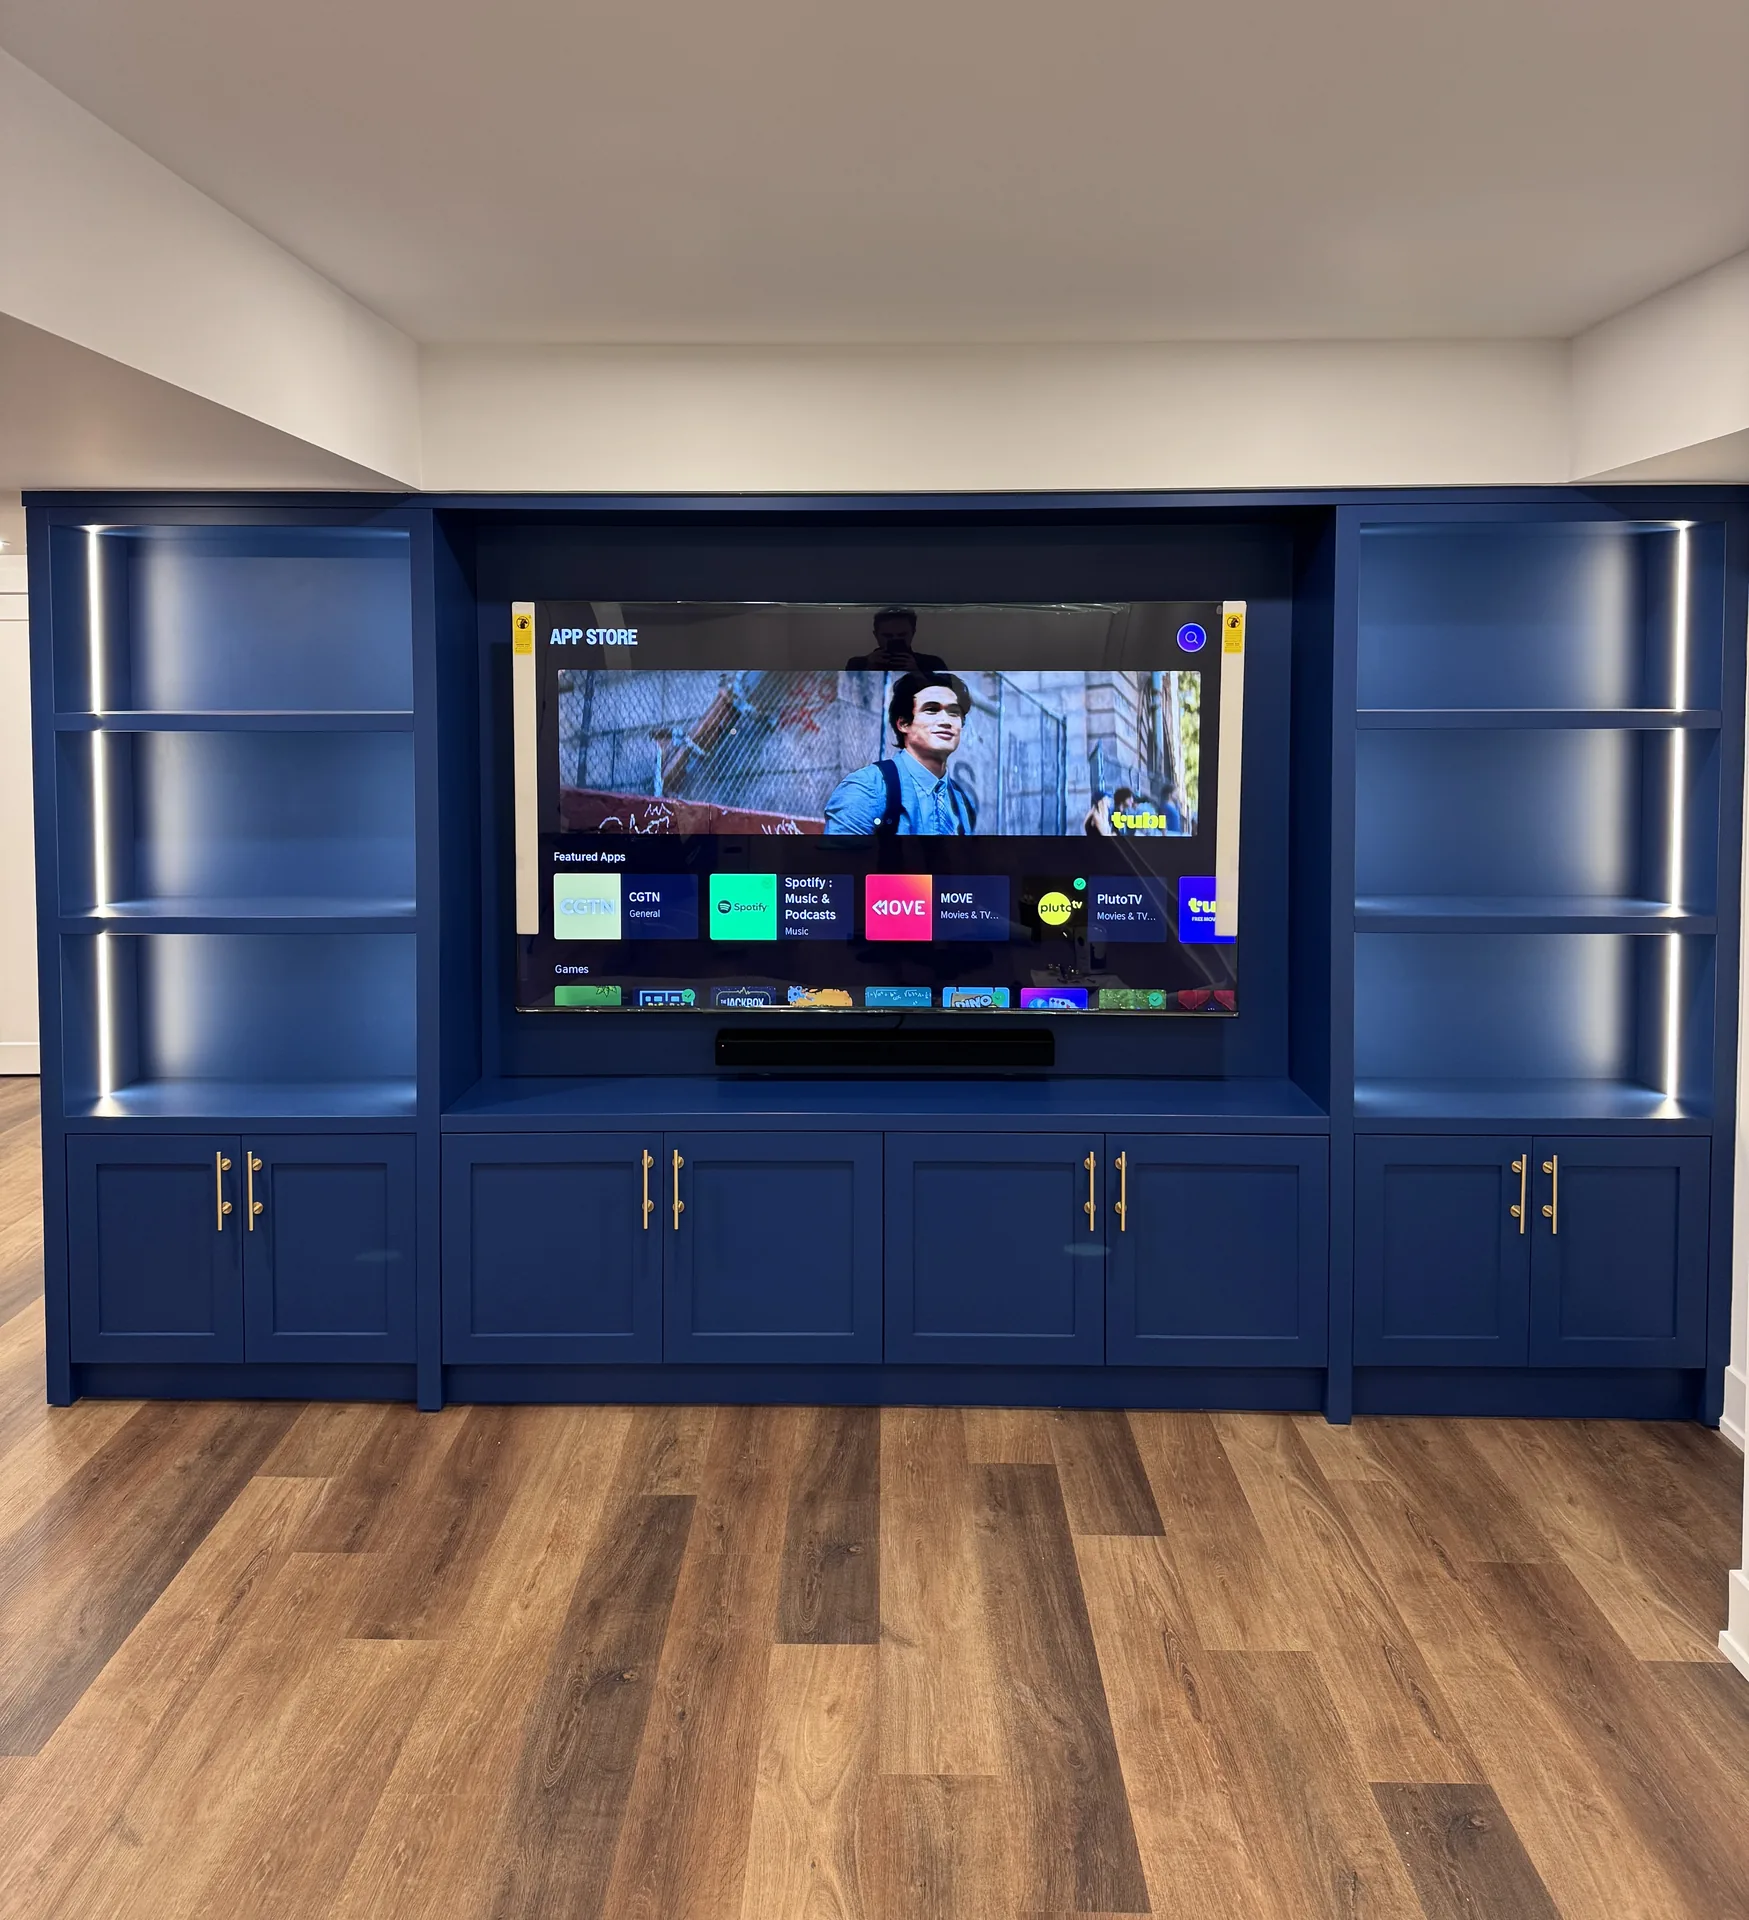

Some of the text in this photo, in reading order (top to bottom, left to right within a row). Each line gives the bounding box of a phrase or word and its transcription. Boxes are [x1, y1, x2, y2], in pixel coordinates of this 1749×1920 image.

[550, 628, 583, 646] APP
[586, 628, 638, 646] STORE
[1111, 811, 1166, 830] tubi
[554, 851, 626, 864] Featured Apps
[785, 877, 826, 890] Spotify
[629, 892, 661, 903] CGTN
[785, 893, 830, 904] Music &
[940, 892, 973, 904] MOVE
[1097, 893, 1143, 905] PlutoTV
[560, 897, 615, 915] CGTN
[734, 902, 767, 913] Spotify
[1187, 897, 1216, 914] tu
[629, 908, 661, 919] General
[785, 909, 837, 920] Podcasts
[940, 910, 969, 920] Movies
[971, 910, 978, 920] &
[1097, 911, 1125, 922] Movies
[1128, 911, 1135, 922] &
[785, 926, 809, 936] Music
[555, 964, 589, 974] Games
